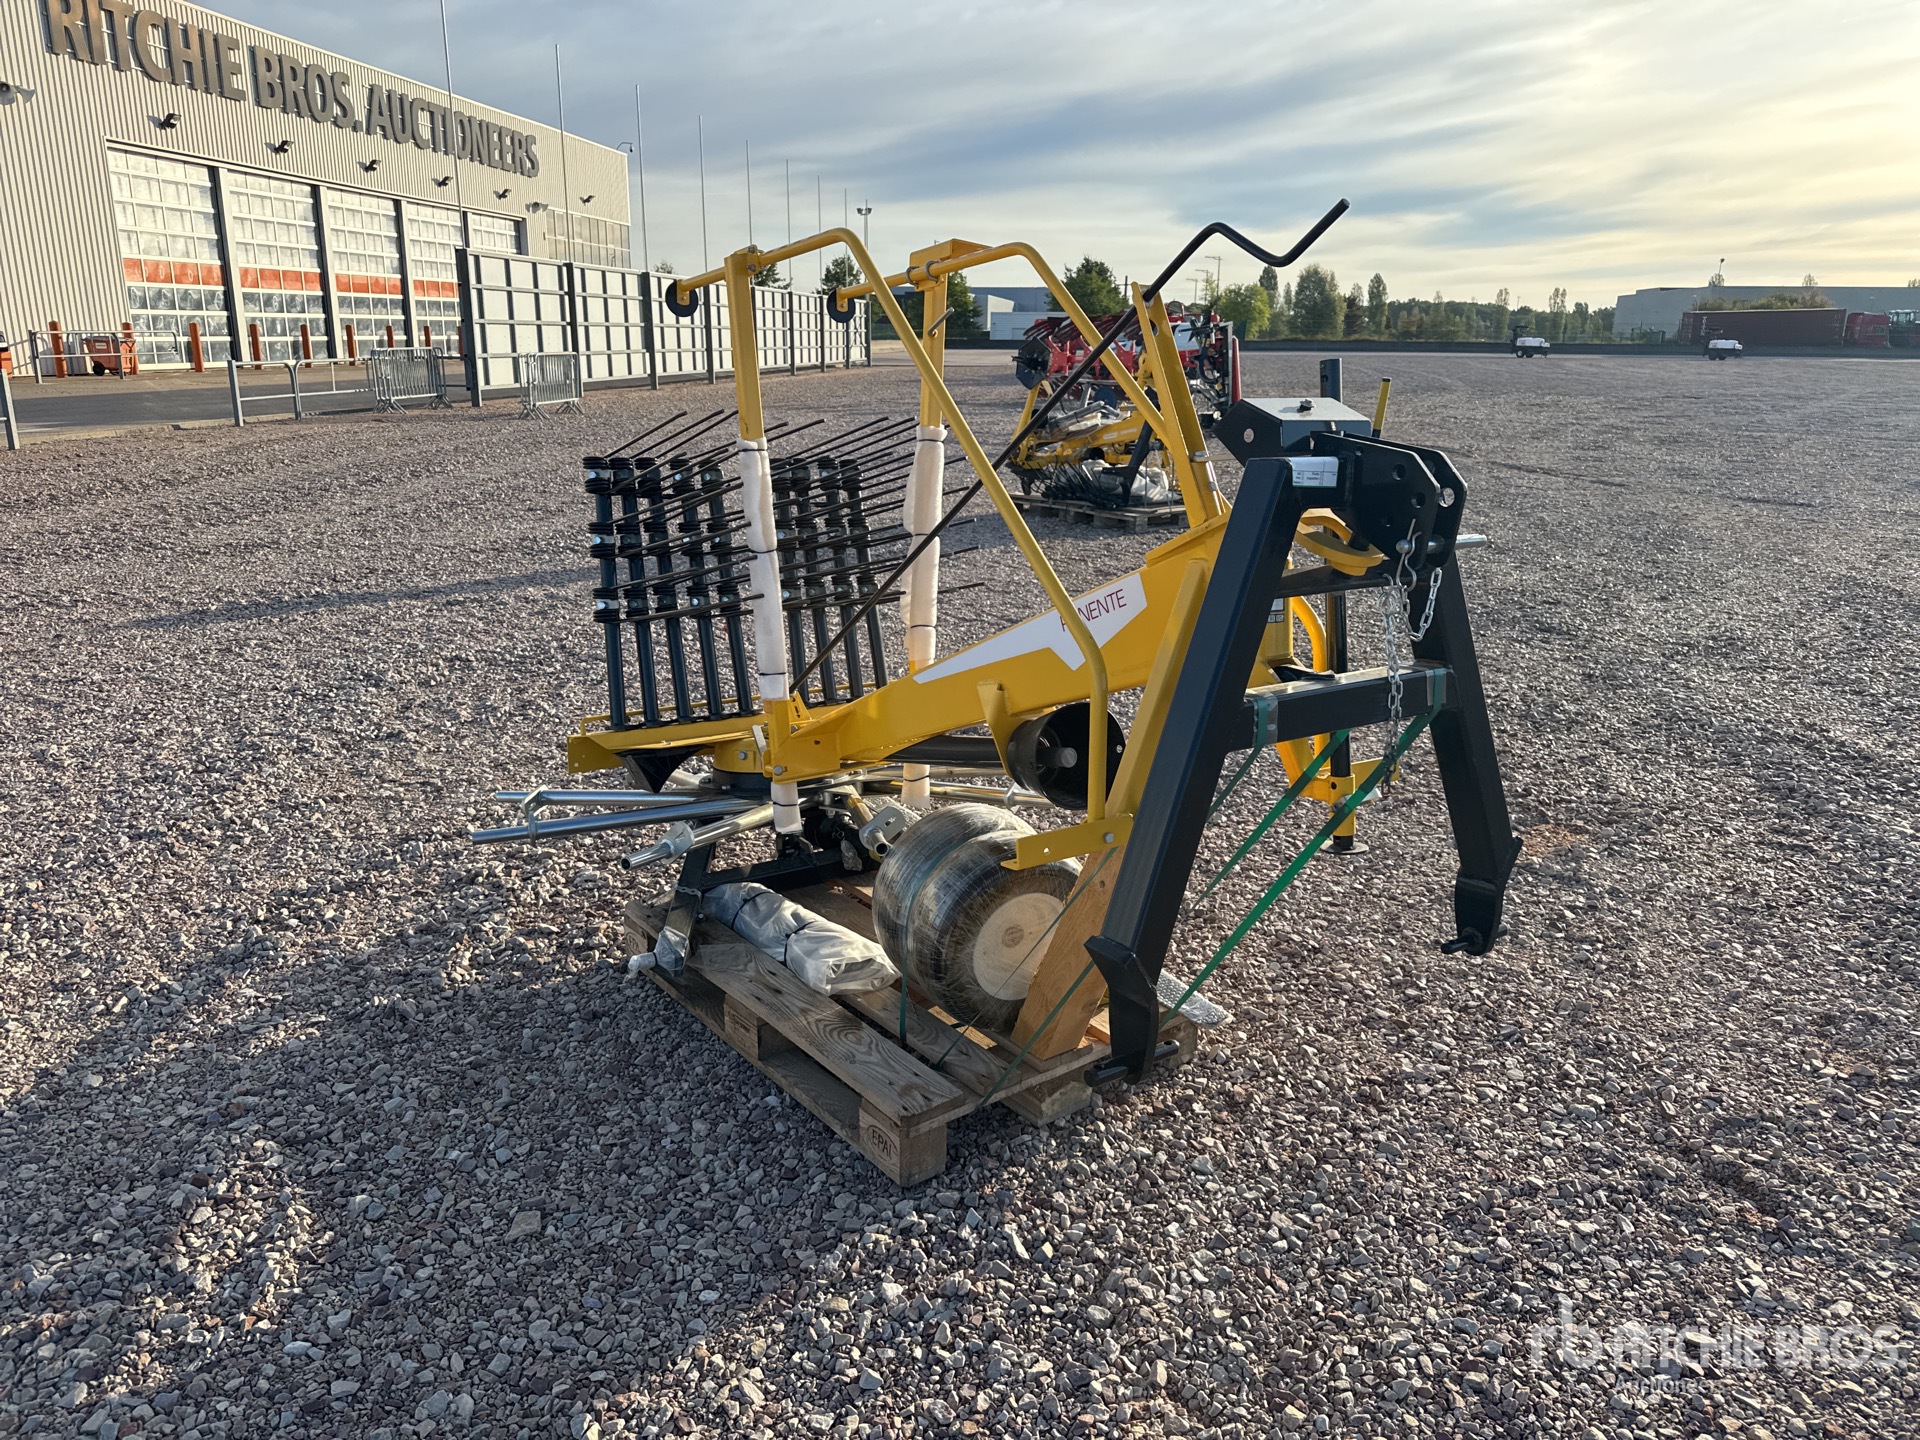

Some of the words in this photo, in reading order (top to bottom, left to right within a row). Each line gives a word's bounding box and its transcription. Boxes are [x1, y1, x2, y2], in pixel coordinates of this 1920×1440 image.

[46, 0, 246, 101] RITCHIE
[250, 45, 363, 133] BROS.
[366, 83, 540, 178] AUCTIONEERS
[1060, 589, 1126, 632] NENTE
